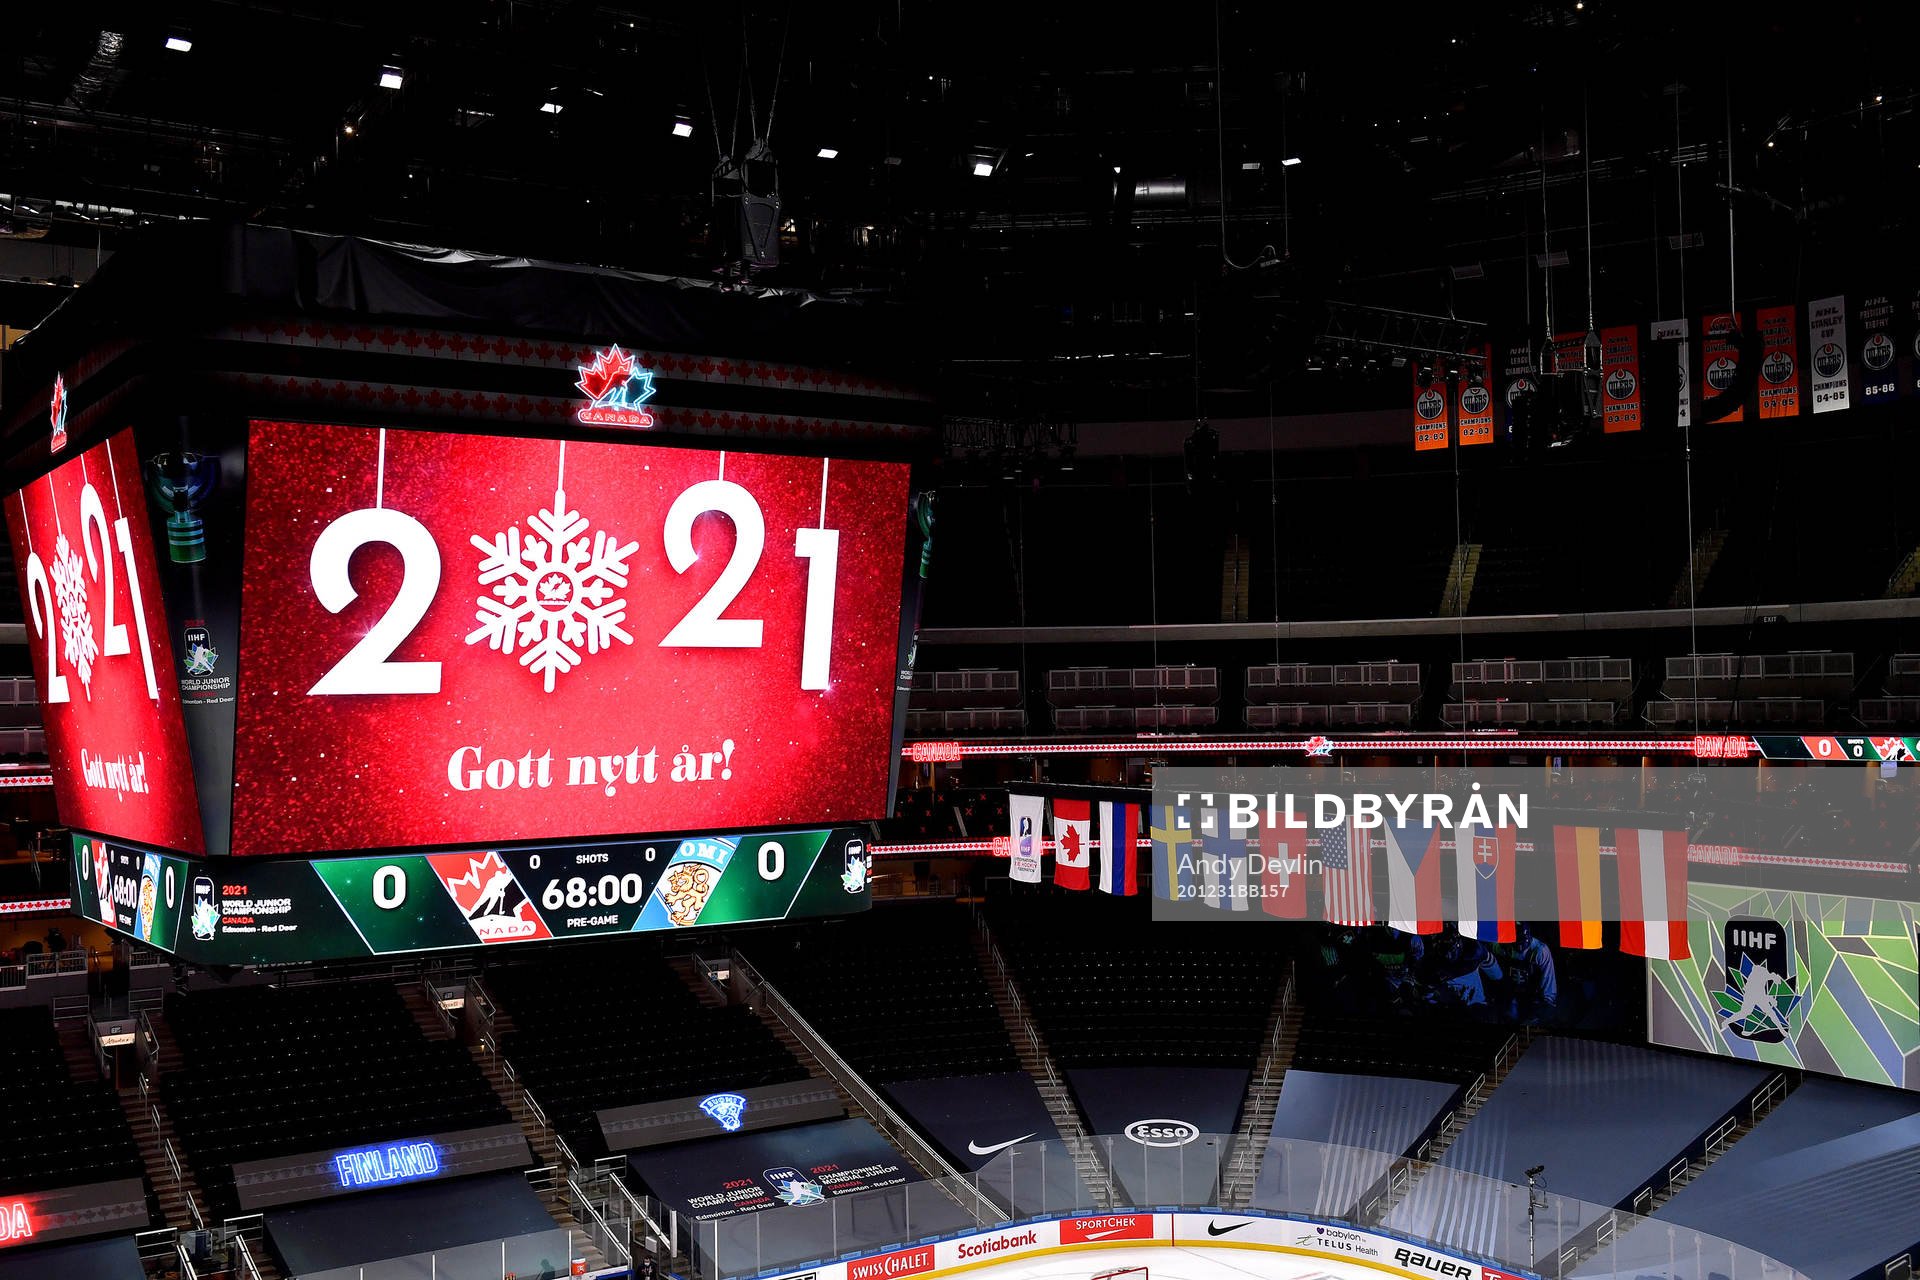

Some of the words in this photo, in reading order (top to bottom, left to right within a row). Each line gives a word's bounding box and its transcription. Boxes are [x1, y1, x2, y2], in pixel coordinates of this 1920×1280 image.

[1760, 387, 1797, 398] CHAMPIONS
[1813, 379, 1847, 392] CHAMPIONS
[1865, 383, 1895, 396] 85-86
[1816, 391, 1845, 403] 84-85
[1604, 403, 1639, 412] CHAMPIONS
[580, 411, 651, 425] CANADA
[1460, 417, 1492, 426] CHAMPIONS
[1415, 422, 1446, 432] CHAMPIONS
[1463, 427, 1489, 436] 82-83
[1418, 432, 1444, 442] 82-83
[187, 633, 206, 641] IIHF
[181, 682, 231, 691] CHAMPIONSHIP
[201, 677, 230, 685] JUNIOR
[912, 741, 962, 762] CANADA
[1694, 736, 1748, 758] CANADA
[1818, 739, 1831, 757] 0
[1853, 745, 1863, 757] 0
[81, 748, 106, 789] Gott
[447, 745, 553, 791] Gott
[568, 743, 659, 796] nytt
[670, 739, 735, 784] år!
[529, 854, 541, 870] 0
[576, 853, 609, 864] SHOTS
[645, 847, 656, 862] 0
[757, 841, 785, 881] 0
[1687, 844, 1741, 866] CANADA
[82, 845, 90, 881] 0
[114, 874, 137, 909] 68:00
[165, 866, 175, 909] 0
[222, 885, 248, 896] 2021
[372, 864, 407, 910] 0
[542, 873, 643, 910] 68:00
[222, 899, 253, 908] WORLD
[254, 898, 292, 907] JUNIOR
[222, 906, 292, 915] CHAMPIONSHIP
[567, 915, 619, 928] PRE-GAME
[262, 925, 277, 933] Red
[1733, 929, 1776, 950] IIHF
[336, 1142, 438, 1187] FINLAND
[810, 1164, 840, 1174] 2021
[769, 1171, 795, 1181] IIHF
[818, 1164, 883, 1180] CHAMPIONNAT
[822, 1174, 865, 1185] MONDIAL
[866, 1165, 899, 1178] JUNIOR
[722, 1179, 754, 1189] 2021
[828, 1181, 864, 1191] CANADA
[832, 1185, 869, 1195] Edmonton
[874, 1181, 889, 1189] Red
[889, 1177, 906, 1185] Deer
[687, 1193, 724, 1204] WORLD
[725, 1186, 762, 1198] JUNIOR
[691, 1190, 765, 1209] CHAMPIONSHIP
[734, 1196, 771, 1208] CANADA
[695, 1209, 736, 1221] Edmonton
[740, 1205, 757, 1213] Red
[757, 1201, 776, 1210] Deer
[1326, 1228, 1362, 1241] babylon
[958, 1230, 1037, 1259] Scotiabank
[1317, 1238, 1352, 1251] TELUS
[1355, 1245, 1379, 1257] Health
[853, 1264, 884, 1280] SWISS
[884, 1252, 929, 1276] CHALET
